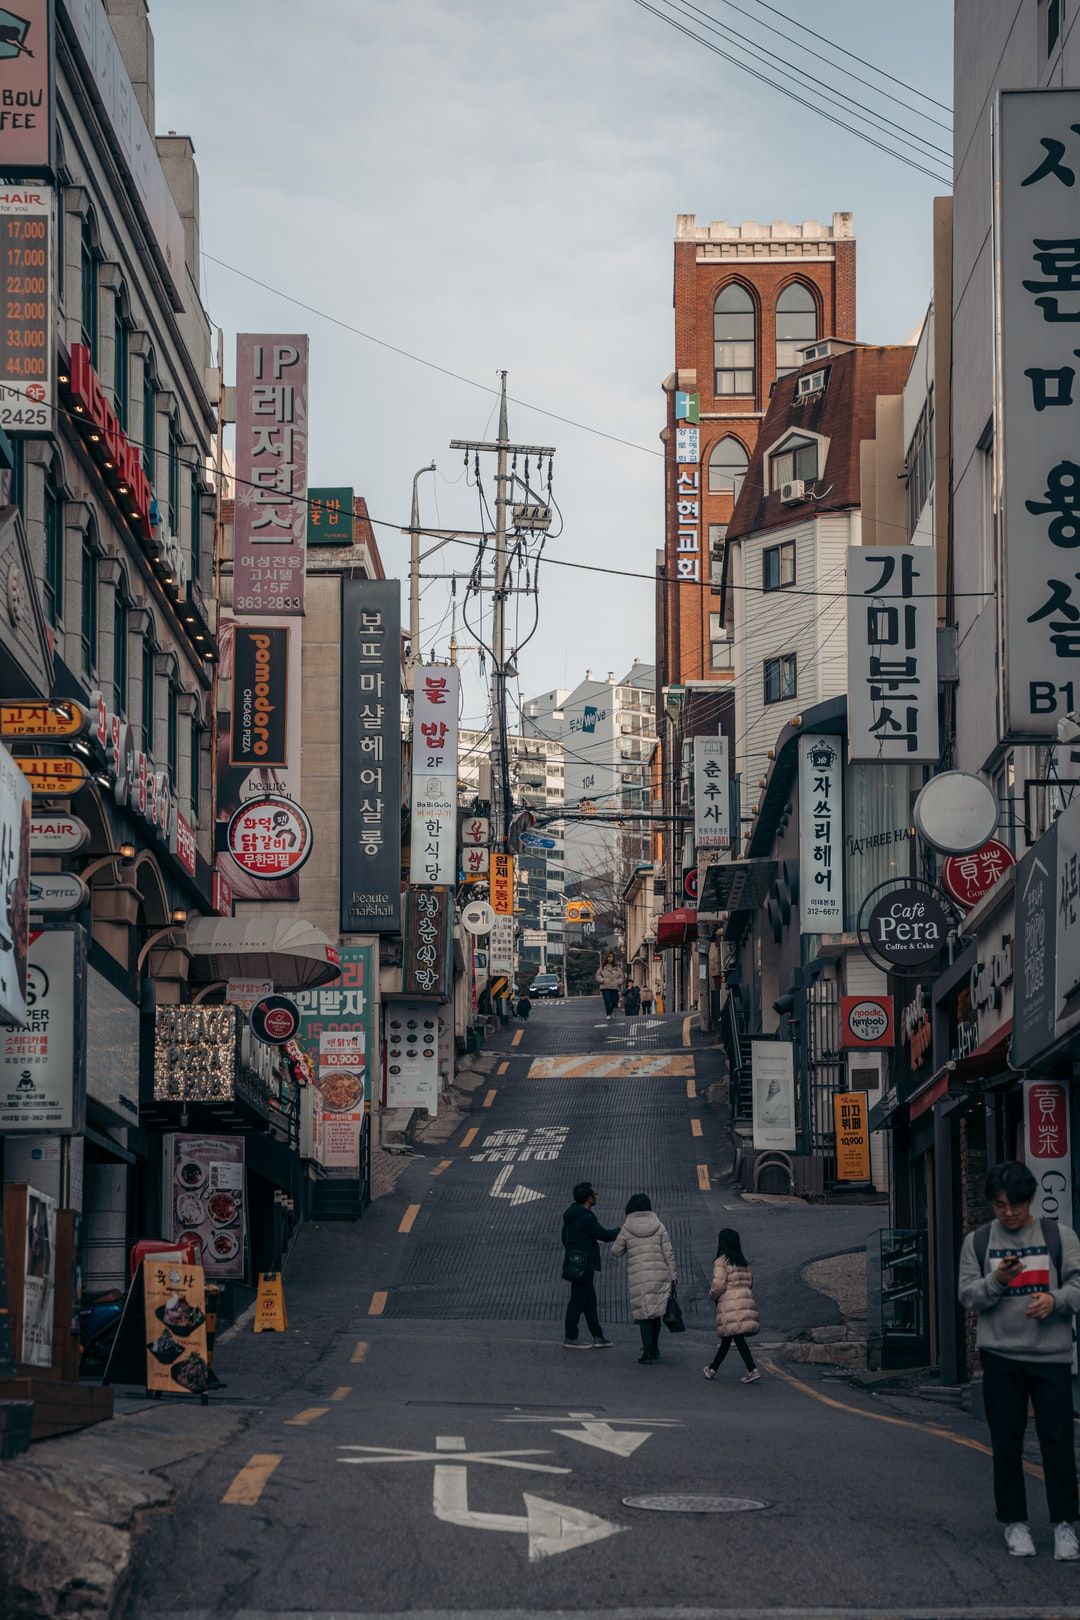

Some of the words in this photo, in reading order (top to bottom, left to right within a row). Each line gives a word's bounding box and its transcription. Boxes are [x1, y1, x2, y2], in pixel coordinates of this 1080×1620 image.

[7, 222, 45, 241] 17,000
[7, 249, 45, 268] 17,000
[6, 276, 45, 295] 22,000
[6, 303, 45, 320] 22,000
[6, 330, 45, 348] 33,000
[6, 357, 45, 376] 44,000
[253, 344, 300, 380] IP
[249, 384, 295, 545] 레지던스
[676, 471, 699, 582] 신현교회
[240, 556, 301, 568] 여성전용
[249, 569, 293, 581] 고시텔
[863, 553, 921, 753] 가미분식
[248, 634, 276, 756] pomodoro
[242, 688, 252, 728] CHICAGO
[242, 729, 251, 754] PIZZA
[426, 756, 444, 768] 2F
[703, 760, 722, 824] 춘추사
[812, 776, 832, 892] 자쓰리헤어
[424, 819, 443, 882] 한식당
[243, 853, 290, 868] 무한리필
[876, 917, 941, 942] Pera
[415, 893, 439, 991] 청춘식당
[885, 943, 908, 951] Coffee
[916, 942, 936, 950] Cake
[5, 1036, 49, 1045] 스터디카페
[326, 1054, 360, 1065] 10,900
[841, 1104, 862, 1118] 피자
[1034, 1088, 1059, 1155] 貢茶
